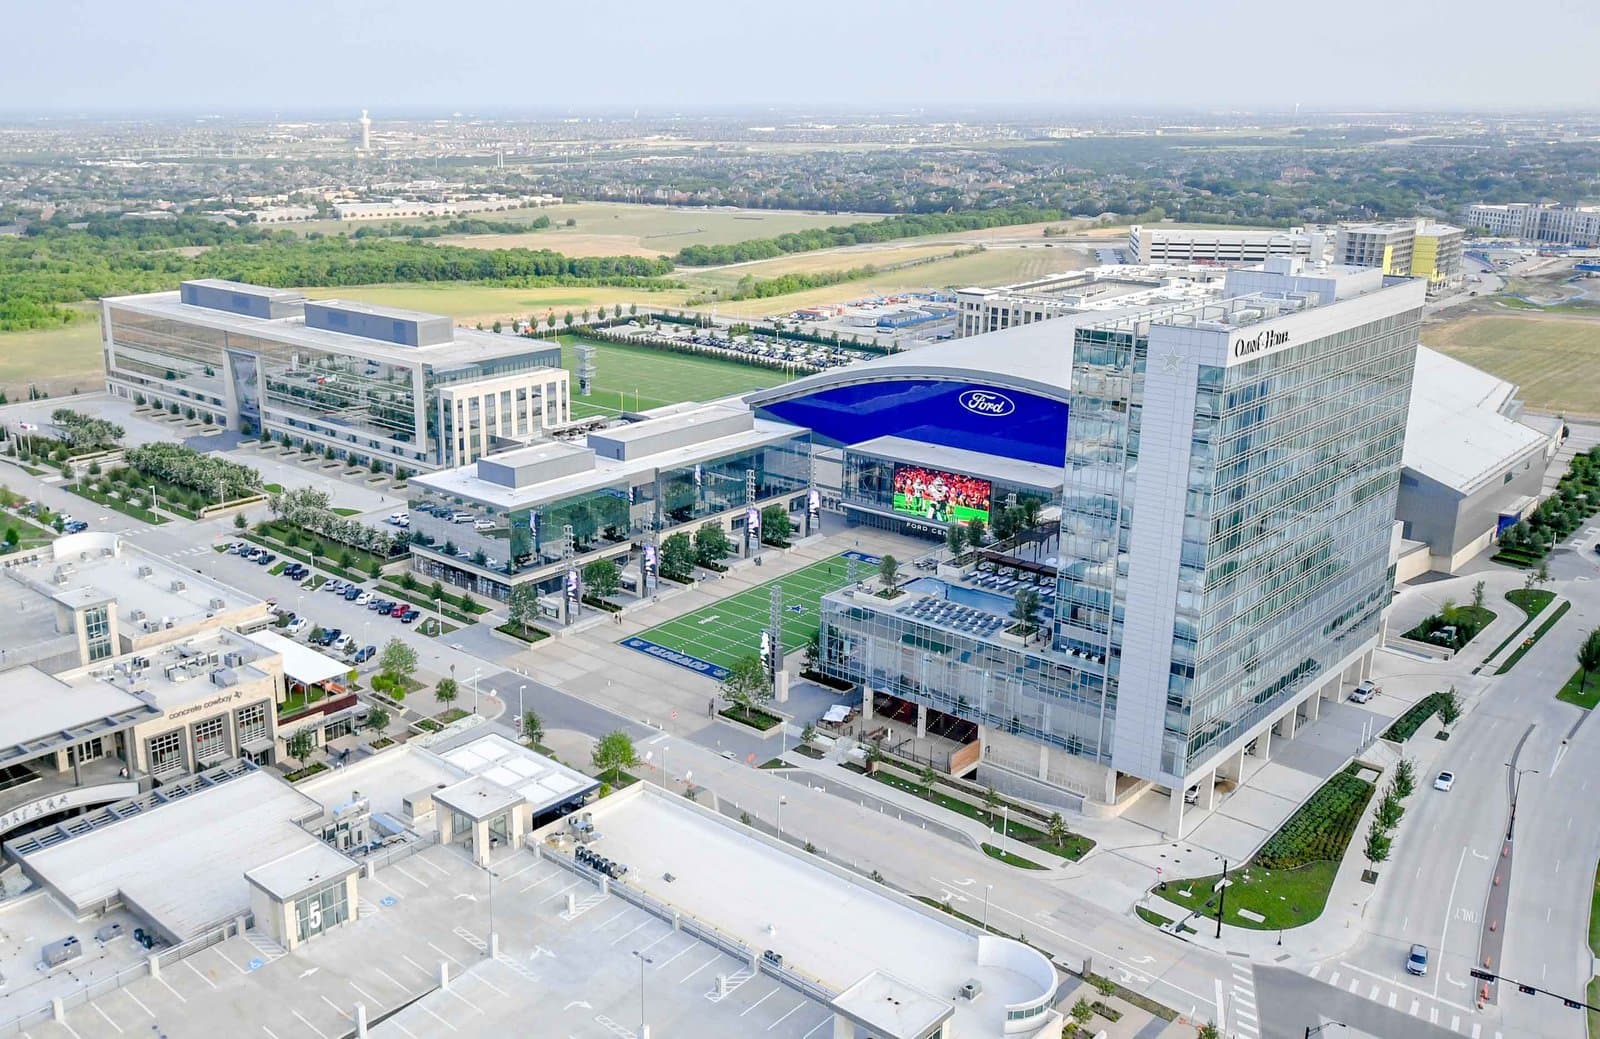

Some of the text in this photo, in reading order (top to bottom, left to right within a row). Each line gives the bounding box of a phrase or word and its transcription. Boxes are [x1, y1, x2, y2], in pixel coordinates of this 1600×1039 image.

[968, 393, 1004, 413] Ford
[906, 522, 928, 532] FORD
[168, 694, 232, 720] concrete cowboy
